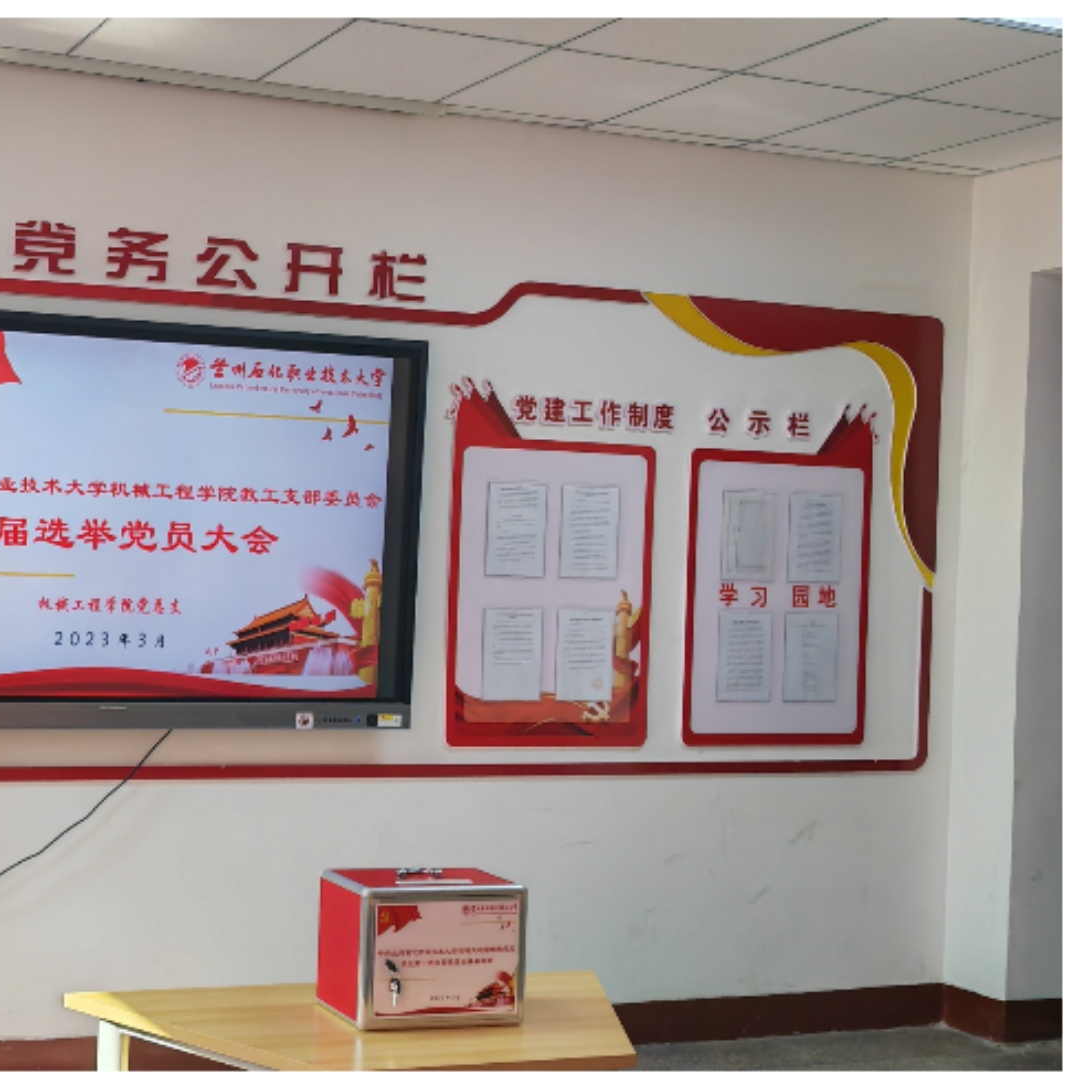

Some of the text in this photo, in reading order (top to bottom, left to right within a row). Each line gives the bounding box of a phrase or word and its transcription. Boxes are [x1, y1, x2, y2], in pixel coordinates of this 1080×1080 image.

[13, 219, 428, 303] 党务公开栏
[514, 395, 811, 438] 党建工作制度 公示栏
[718, 582, 838, 608] 学习园地
[53, 630, 165, 649] 2023年3月
